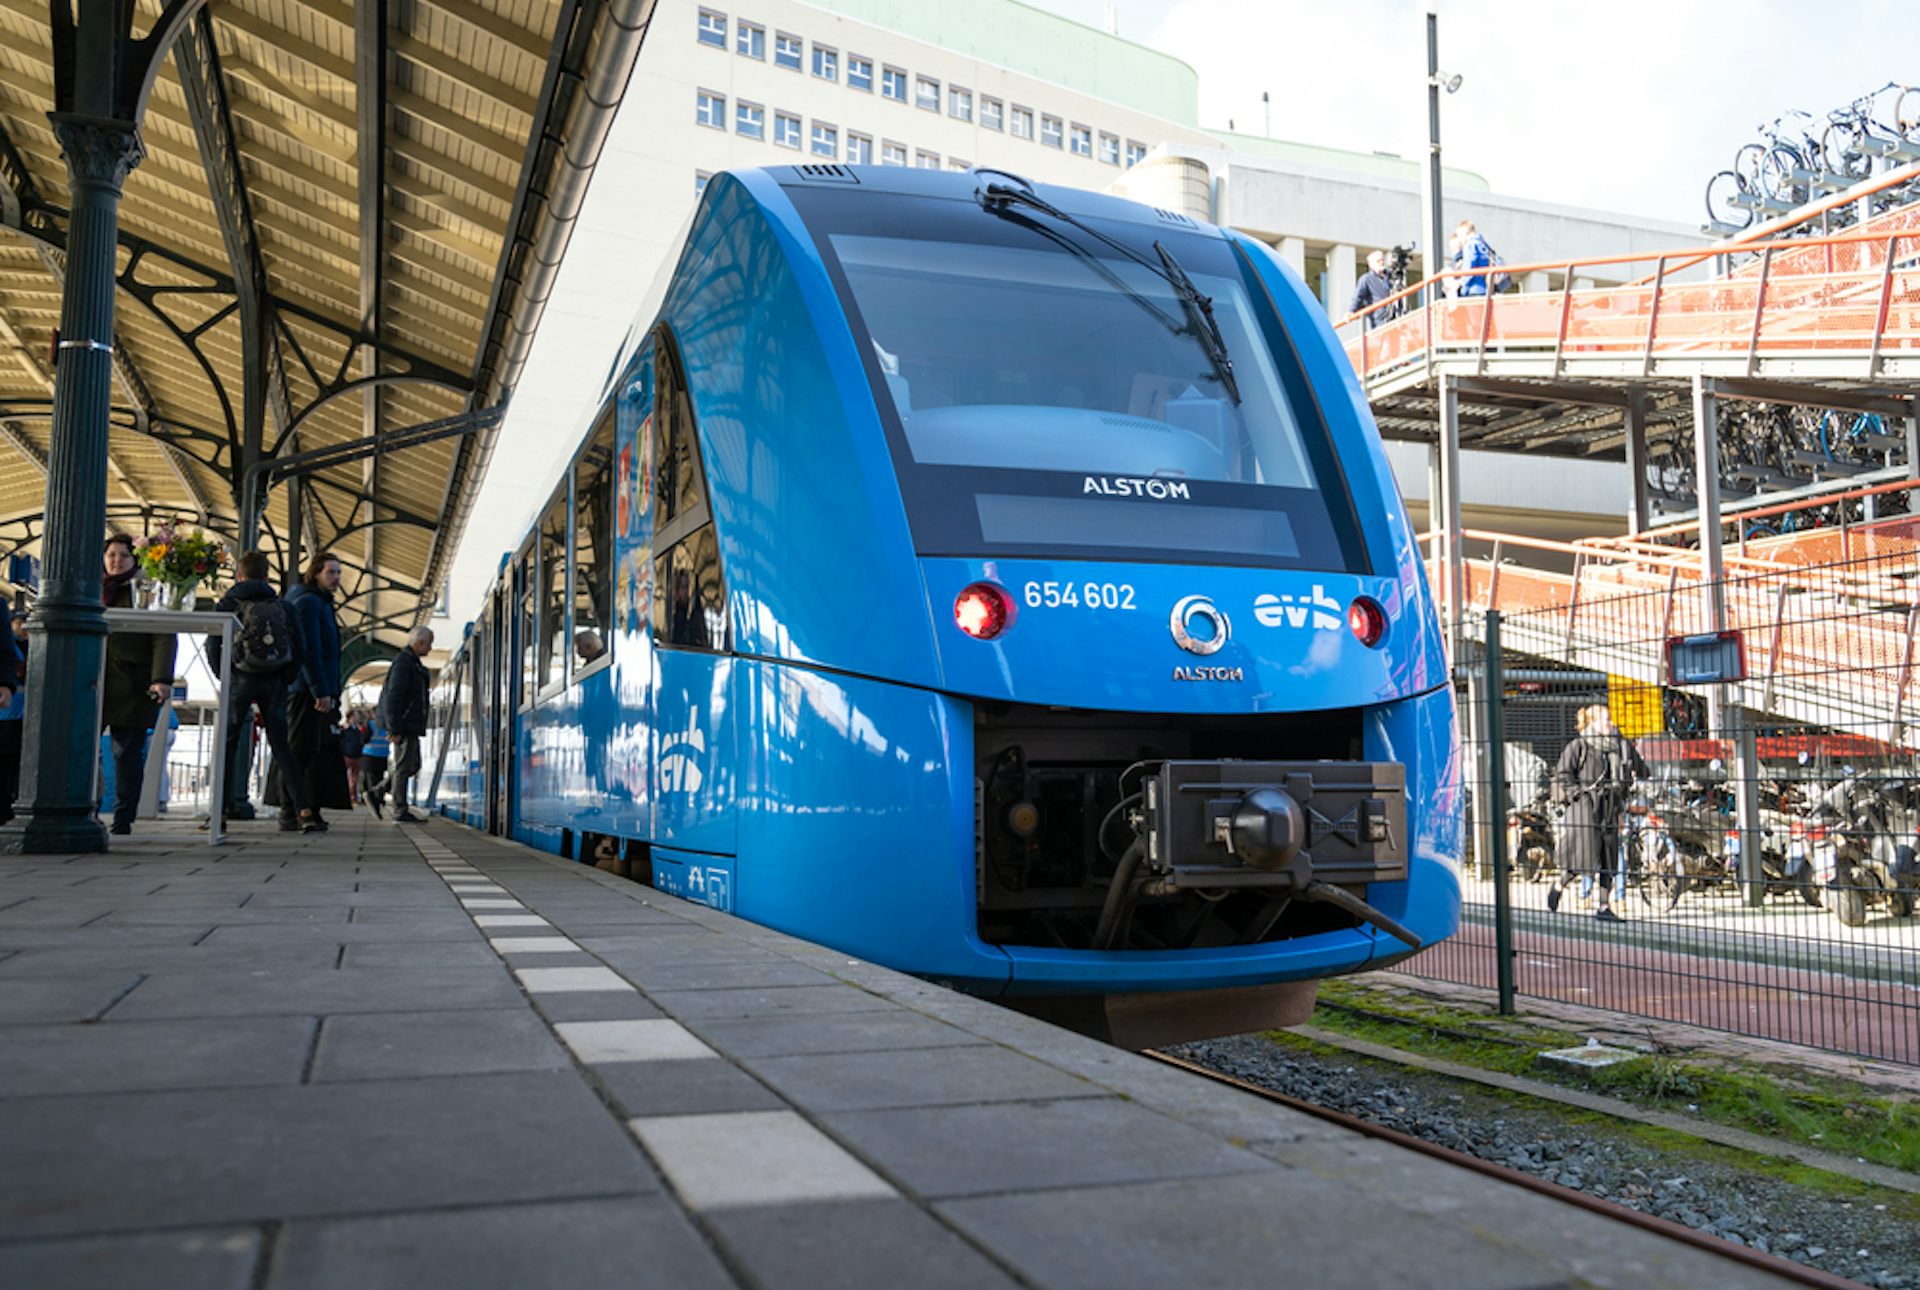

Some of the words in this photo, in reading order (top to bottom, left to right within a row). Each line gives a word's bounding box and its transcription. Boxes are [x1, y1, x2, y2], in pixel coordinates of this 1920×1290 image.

[1083, 477, 1191, 500] ALSTOM
[1024, 581, 1079, 608] 654
[1084, 582, 1137, 610] 602
[1253, 584, 1342, 630] evb
[1173, 666, 1244, 681] ALSTOM
